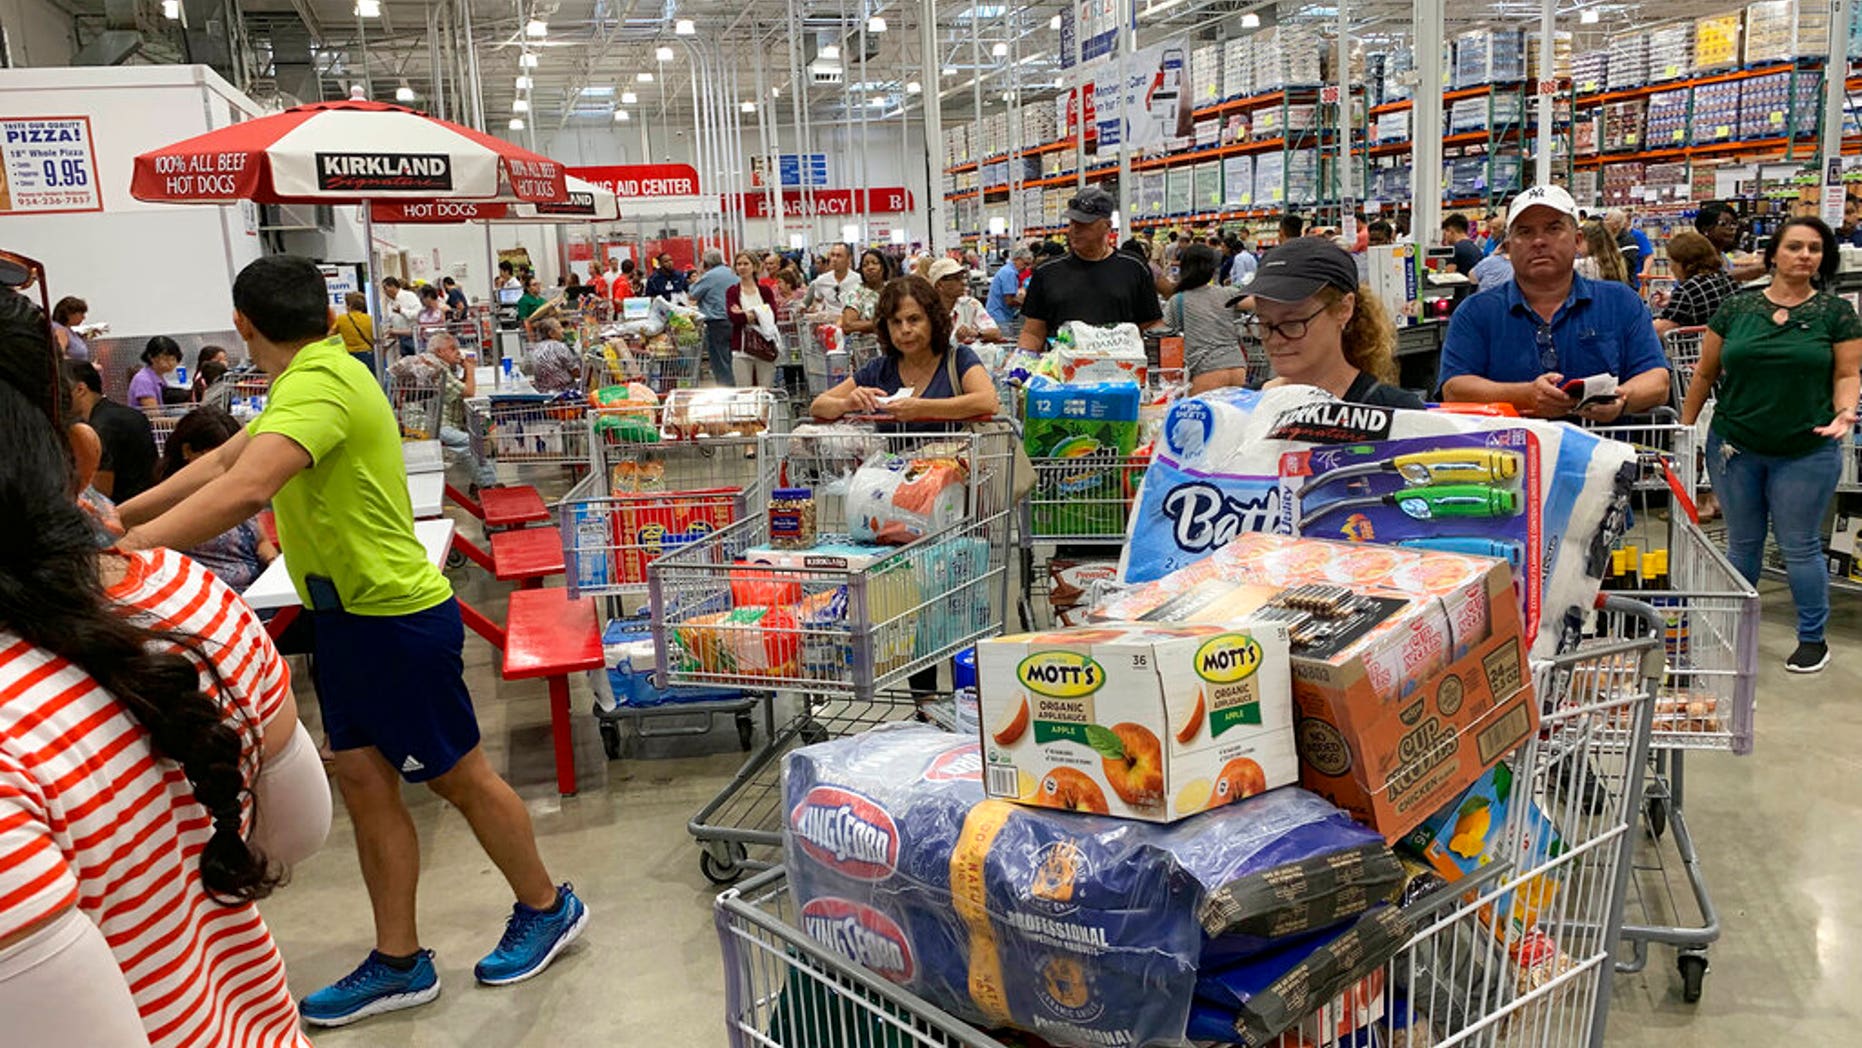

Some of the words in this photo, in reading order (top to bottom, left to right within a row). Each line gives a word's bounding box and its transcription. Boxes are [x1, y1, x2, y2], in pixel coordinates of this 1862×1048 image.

[7, 129, 81, 143] PIZZA!
[29, 149, 57, 157] Whole
[155, 155, 186, 173] 100%
[189, 153, 214, 171] ALL
[218, 152, 248, 171] BEEF
[324, 156, 447, 176] KIRKLAND
[43, 159, 88, 187] 9.95
[326, 174, 446, 190] Signature
[166, 177, 195, 194] HOT
[199, 175, 235, 193] DOGS
[616, 180, 639, 196] AID
[641, 178, 692, 195] CENTER
[403, 203, 433, 218] HOT
[437, 203, 478, 217] DOGS
[758, 198, 848, 216] PARACY
[1036, 399, 1052, 412] 12
[1275, 404, 1387, 432] KIRKLAND
[1132, 655, 1147, 666] 36
[1203, 645, 1256, 672] MOTT'S
[1027, 665, 1094, 685] MOTT'S
[1214, 684, 1250, 699] ORGANIC
[1039, 700, 1084, 712] ORGANIC
[1215, 694, 1252, 708] APPLESAUCE
[1038, 711, 1087, 722] APPLESAUCE
[1225, 709, 1244, 720] APPLE
[1051, 726, 1075, 735] APPLE
[1401, 718, 1438, 762] CUP
[1386, 727, 1459, 801] NOODLES
[1398, 777, 1438, 811] CHICKEN
[797, 805, 890, 865] KINGSFORD
[1006, 911, 1109, 948] PROFESSIONAL
[805, 916, 905, 972] KINGSFORD
